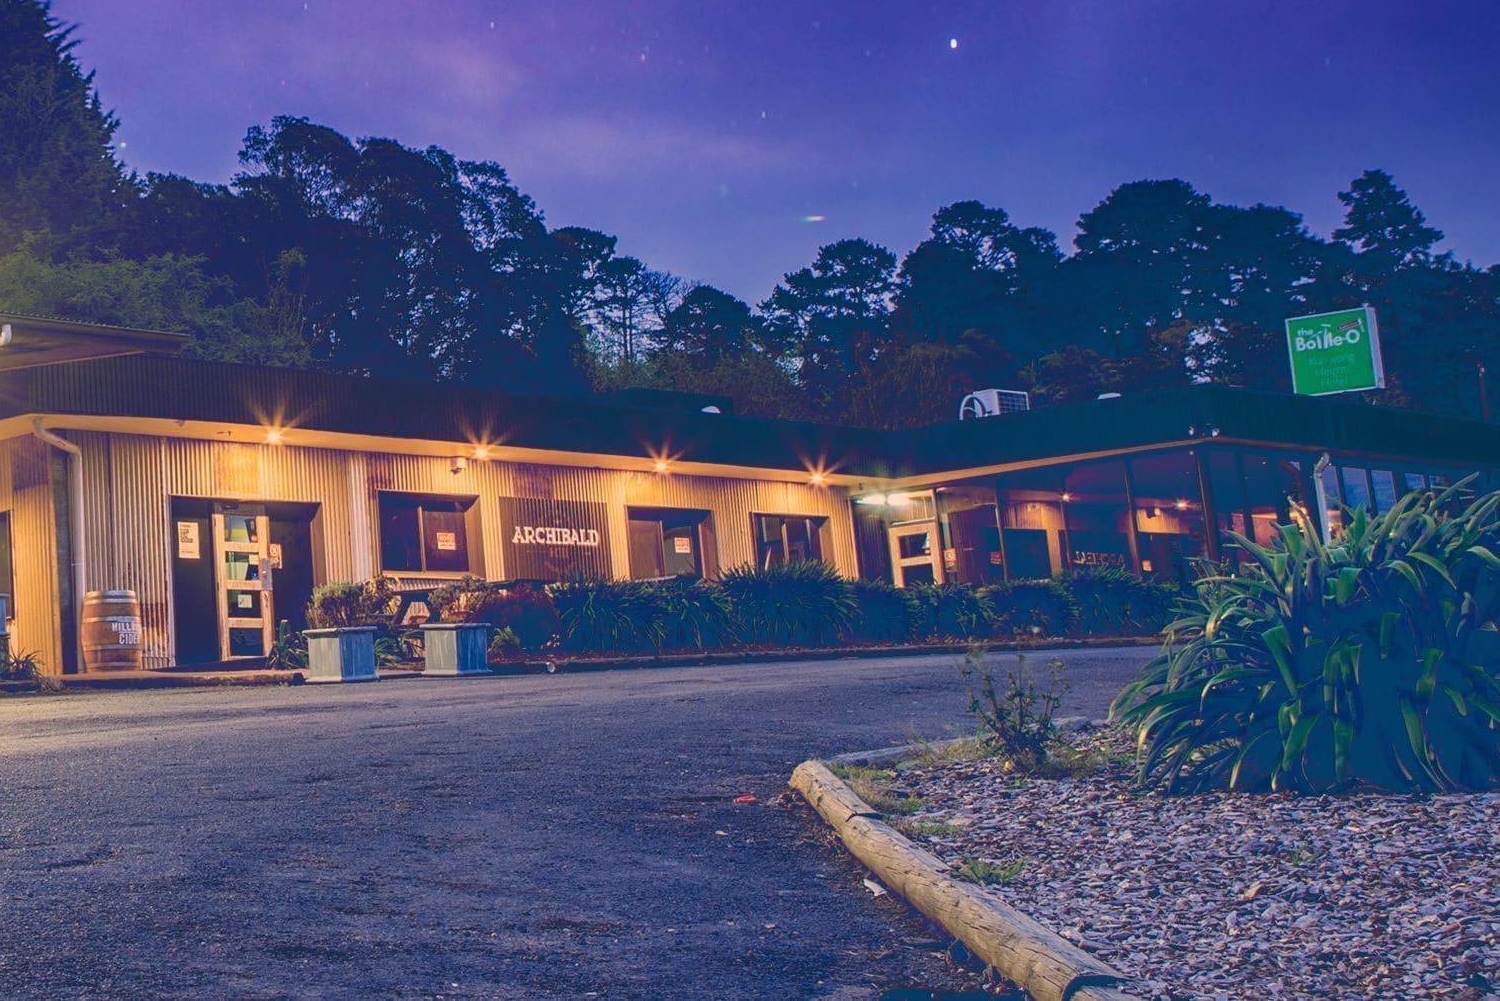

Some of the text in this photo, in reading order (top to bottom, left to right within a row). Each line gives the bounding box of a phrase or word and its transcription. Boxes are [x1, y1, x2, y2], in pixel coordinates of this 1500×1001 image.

[1295, 324, 1361, 352] Bottle-O
[1297, 328, 1314, 337] the
[511, 525, 599, 546] ARCHIBALD
